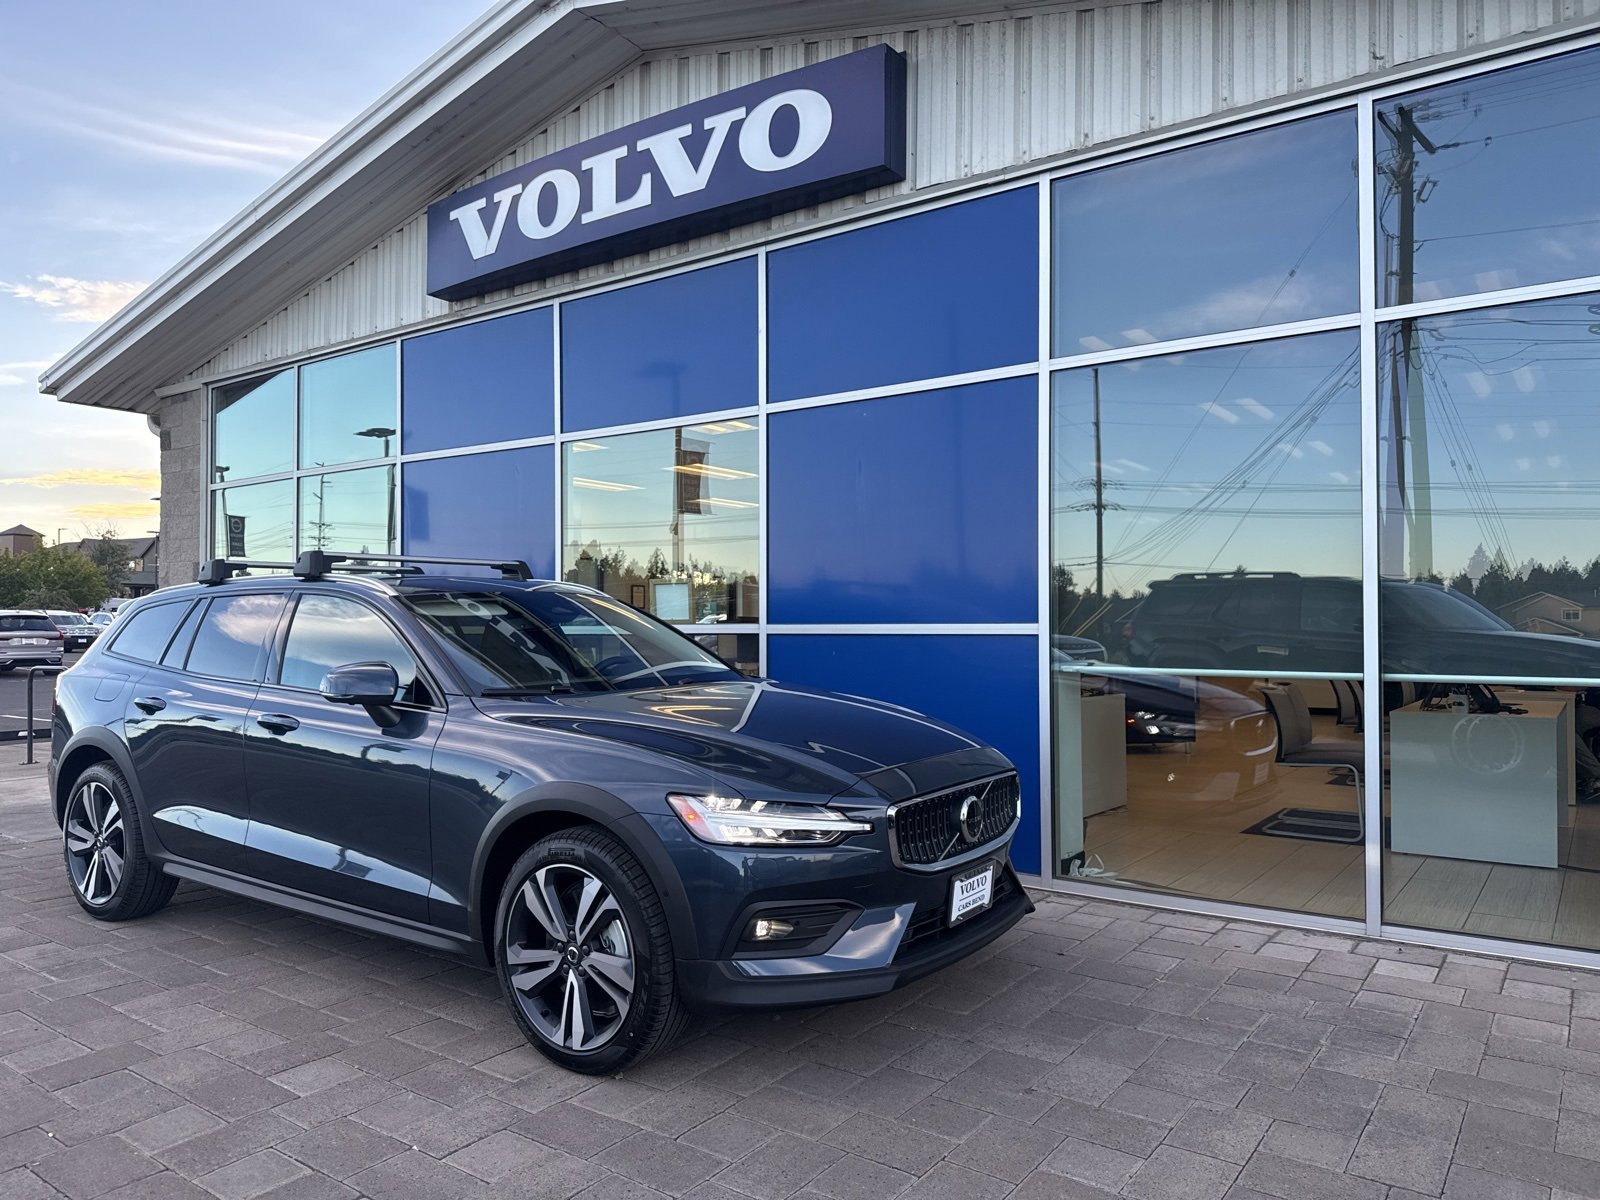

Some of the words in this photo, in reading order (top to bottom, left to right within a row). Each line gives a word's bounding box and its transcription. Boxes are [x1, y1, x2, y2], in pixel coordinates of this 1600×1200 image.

[449, 88, 833, 260] VOLVO
[960, 875, 987, 895] VOLVO
[958, 901, 971, 912] CARS
